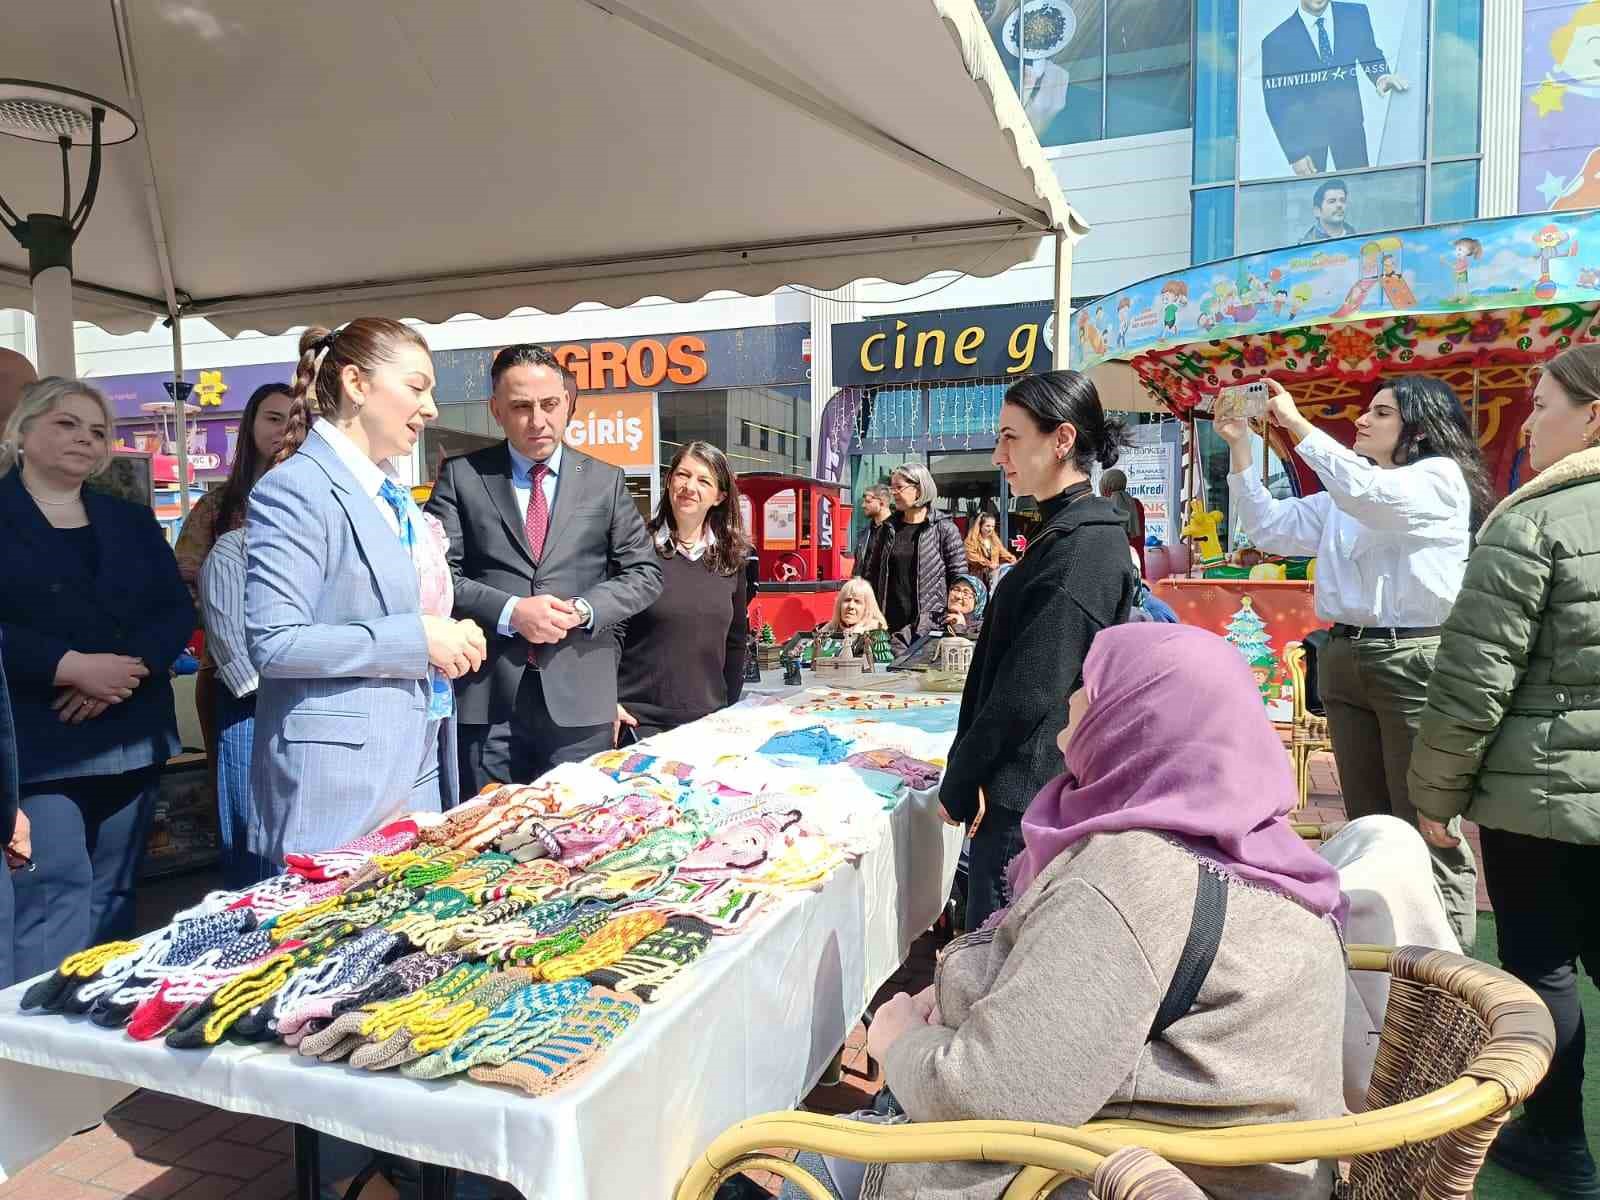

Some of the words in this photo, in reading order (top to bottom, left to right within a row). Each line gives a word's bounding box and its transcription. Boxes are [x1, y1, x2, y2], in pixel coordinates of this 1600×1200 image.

[1264, 71, 1328, 89] ALTINYILDIZ
[549, 336, 708, 391] GROS
[860, 319, 985, 372] cine
[565, 410, 643, 451] GİRİŞ
[1126, 484, 1164, 497] apıKredi
